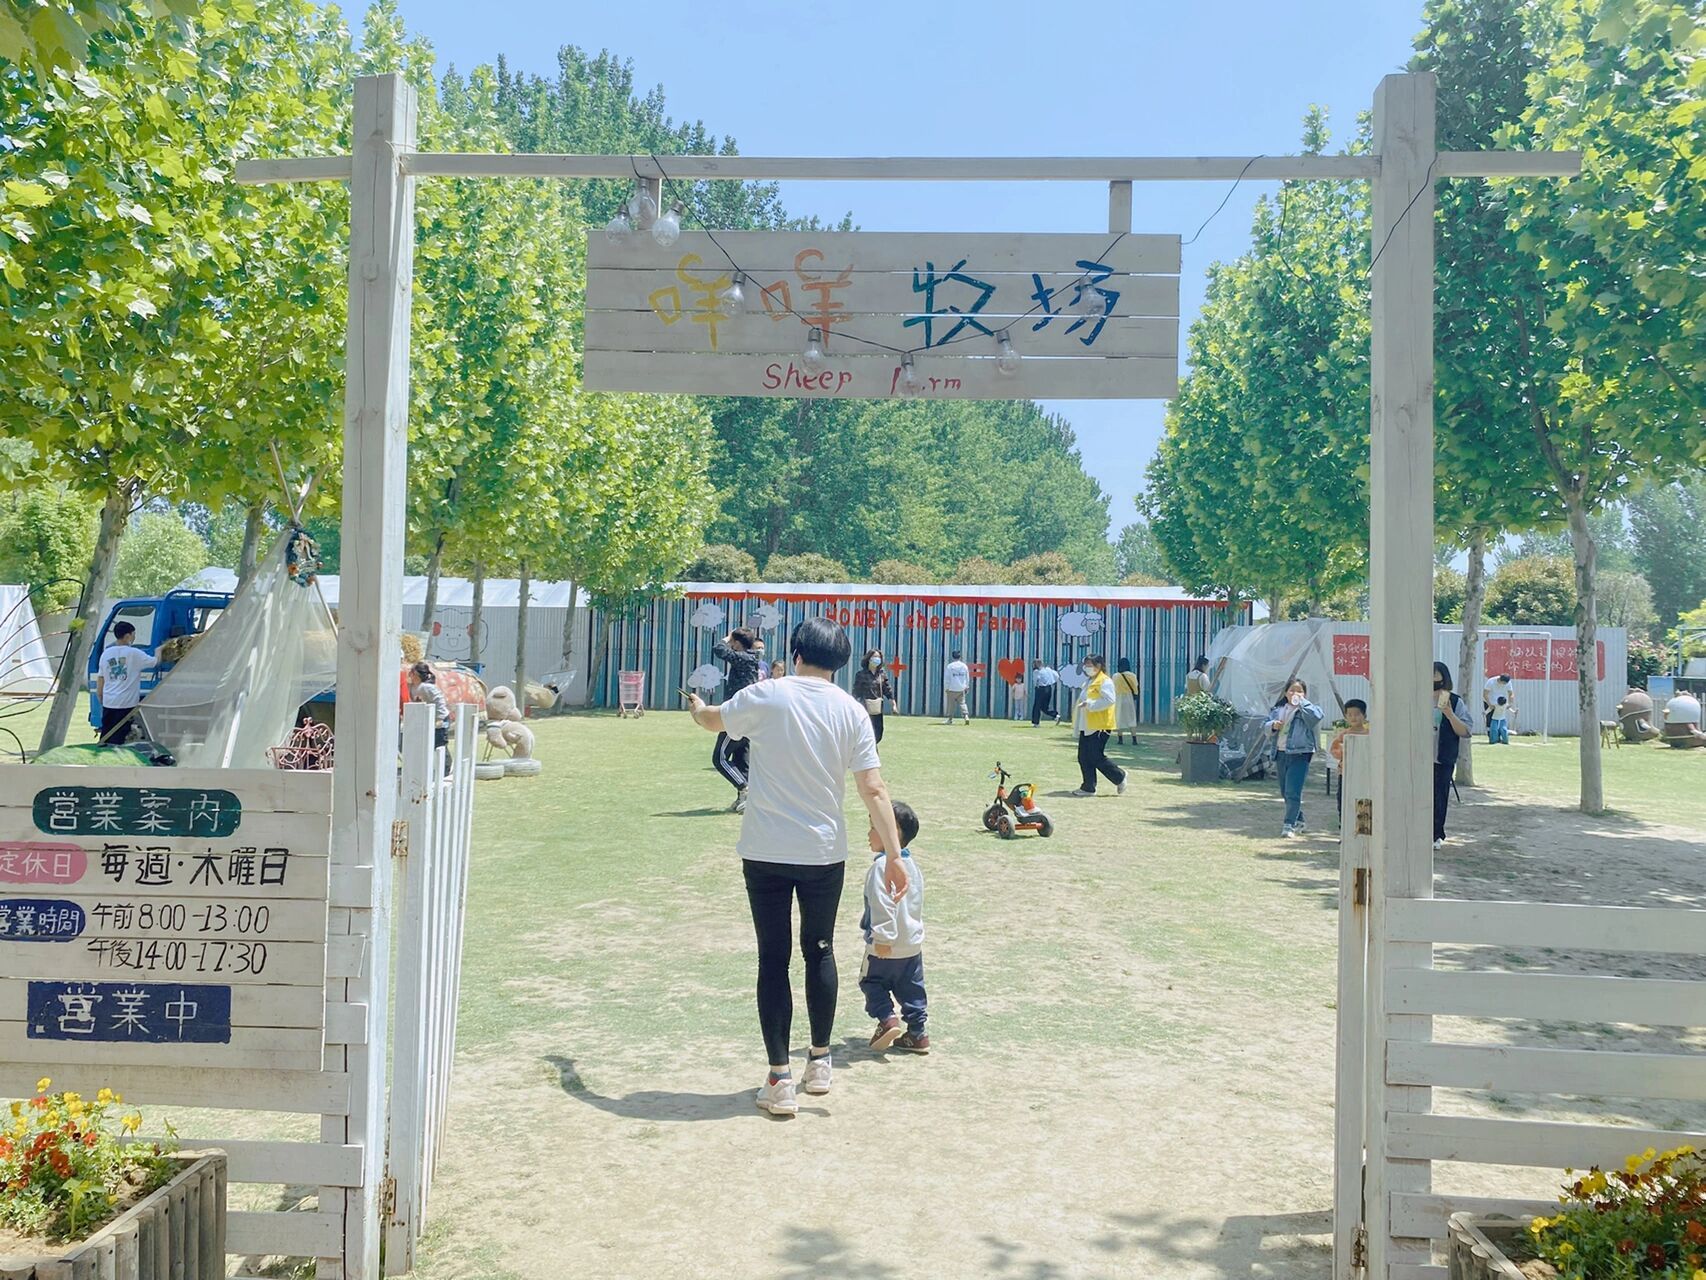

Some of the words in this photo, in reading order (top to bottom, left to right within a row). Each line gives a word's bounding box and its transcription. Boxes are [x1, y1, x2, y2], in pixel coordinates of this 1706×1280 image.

[825, 607, 892, 629] HONEY
[906, 610, 964, 635] sheep
[977, 612, 1027, 632] Farm
[49, 789, 220, 833] 営業案内
[57, 986, 199, 1039] 営業中
